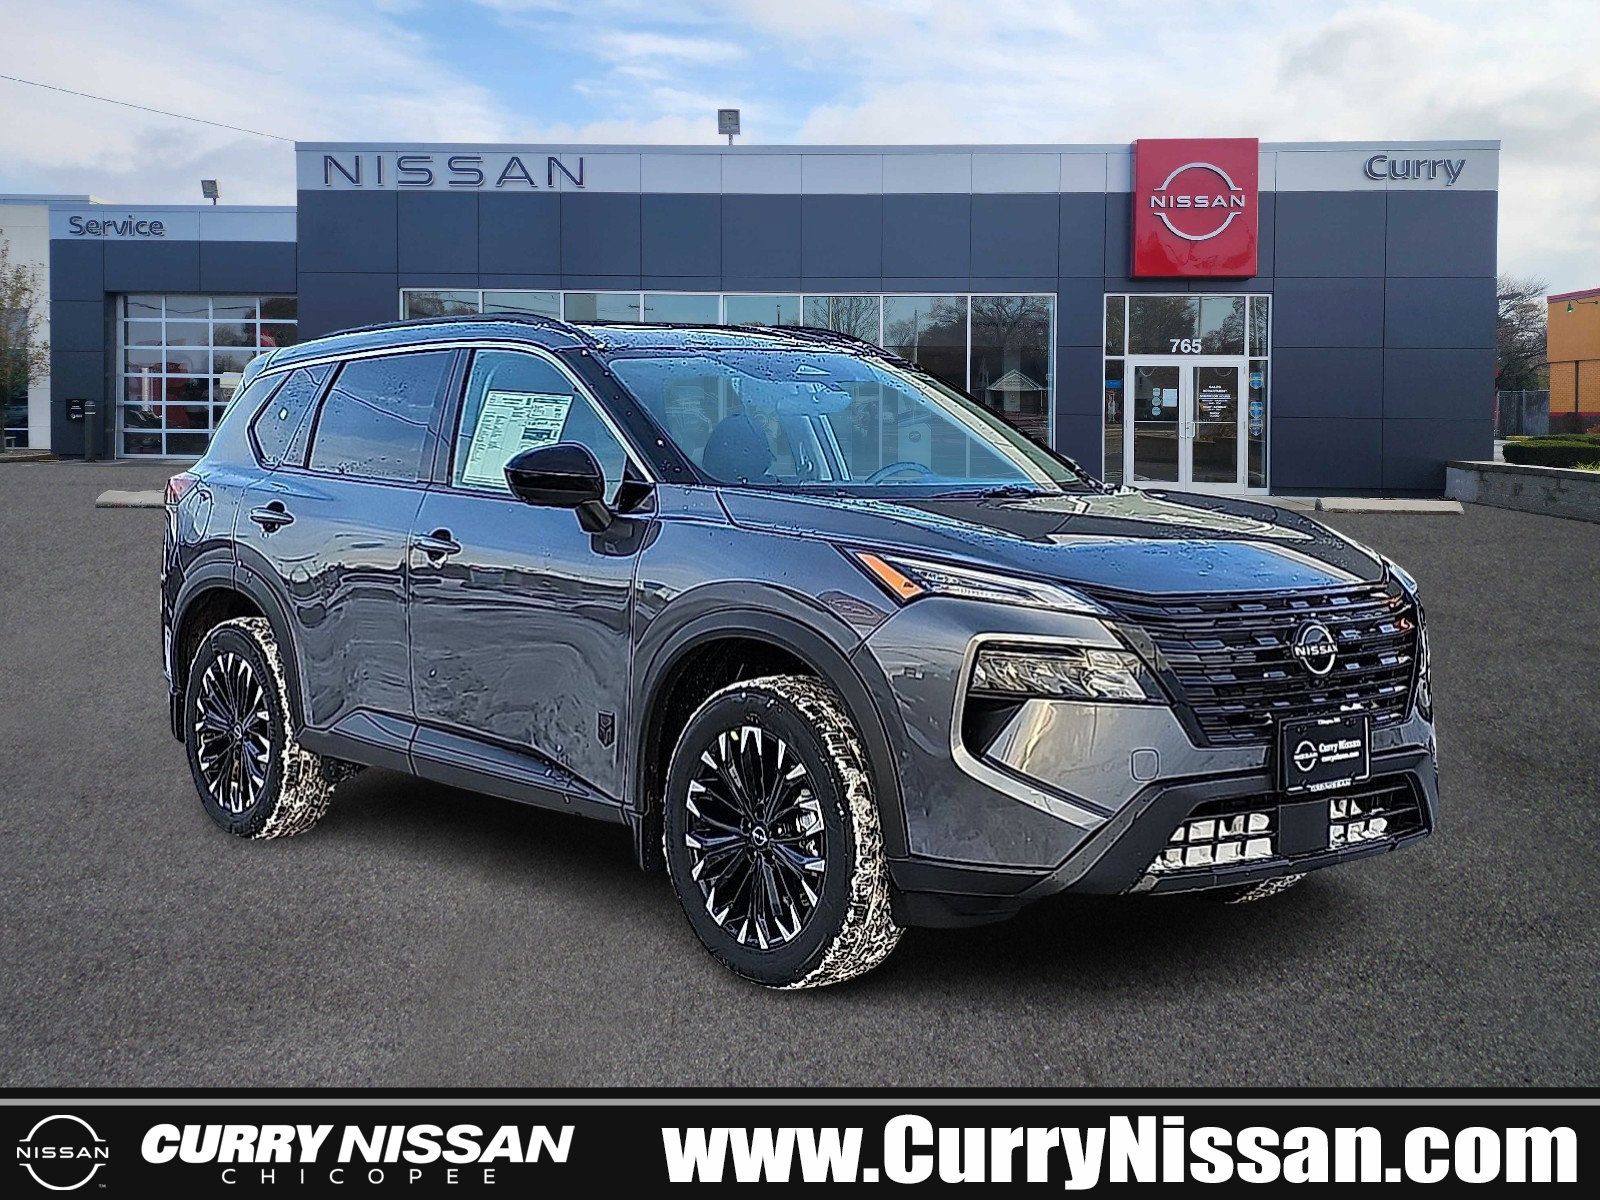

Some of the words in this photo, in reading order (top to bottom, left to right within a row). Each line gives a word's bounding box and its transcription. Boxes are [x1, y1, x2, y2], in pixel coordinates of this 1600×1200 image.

[324, 155, 586, 188] NISSAN
[1364, 154, 1467, 186] Curry
[1150, 194, 1246, 208] NISSAN
[69, 214, 165, 236] Service
[1169, 338, 1202, 354] 765
[1294, 643, 1338, 656] NISSAN
[1318, 742, 1338, 753] Curry
[1338, 739, 1361, 750] Nissan
